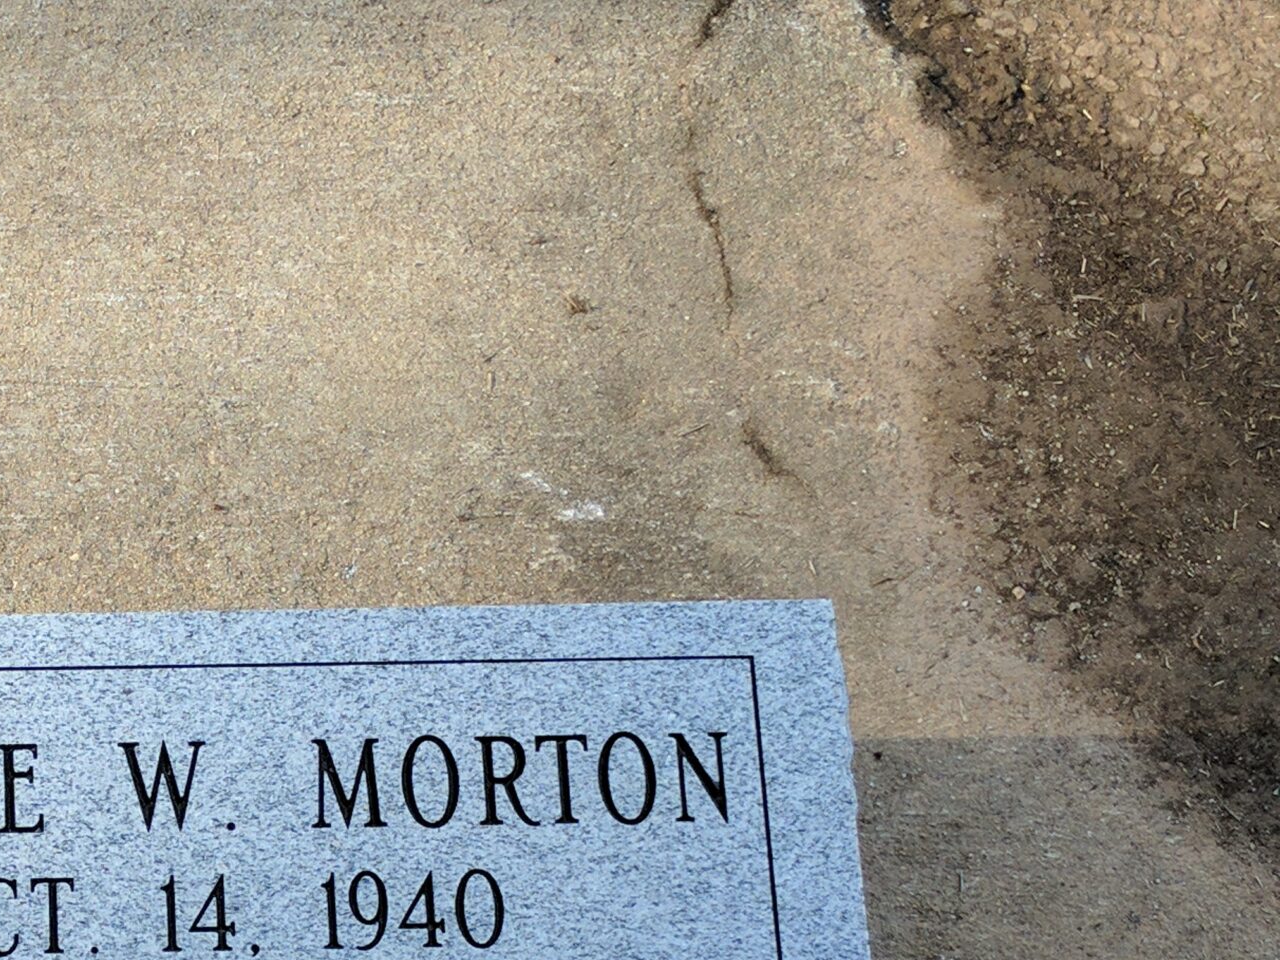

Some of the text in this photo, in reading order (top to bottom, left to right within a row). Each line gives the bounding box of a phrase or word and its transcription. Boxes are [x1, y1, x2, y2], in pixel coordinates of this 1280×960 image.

[118, 739, 237, 832] W.
[311, 730, 730, 829] MORTON
[158, 873, 261, 957] 14,
[320, 868, 506, 950] 1940
